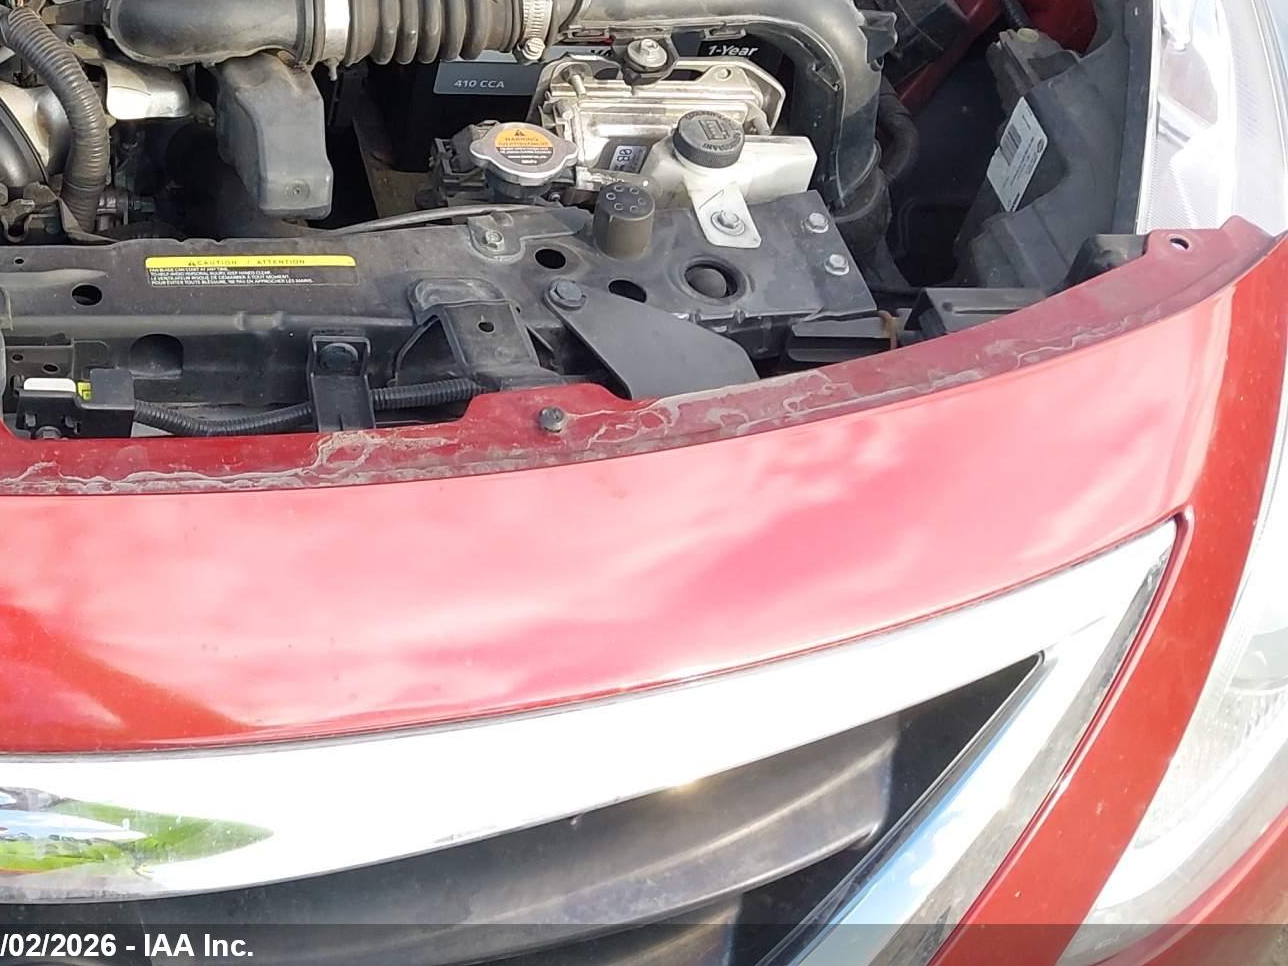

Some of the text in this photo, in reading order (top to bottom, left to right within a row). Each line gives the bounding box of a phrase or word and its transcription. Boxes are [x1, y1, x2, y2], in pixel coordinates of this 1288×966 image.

[708, 44, 759, 56] 1-Year
[453, 79, 505, 89] 410 CCA
